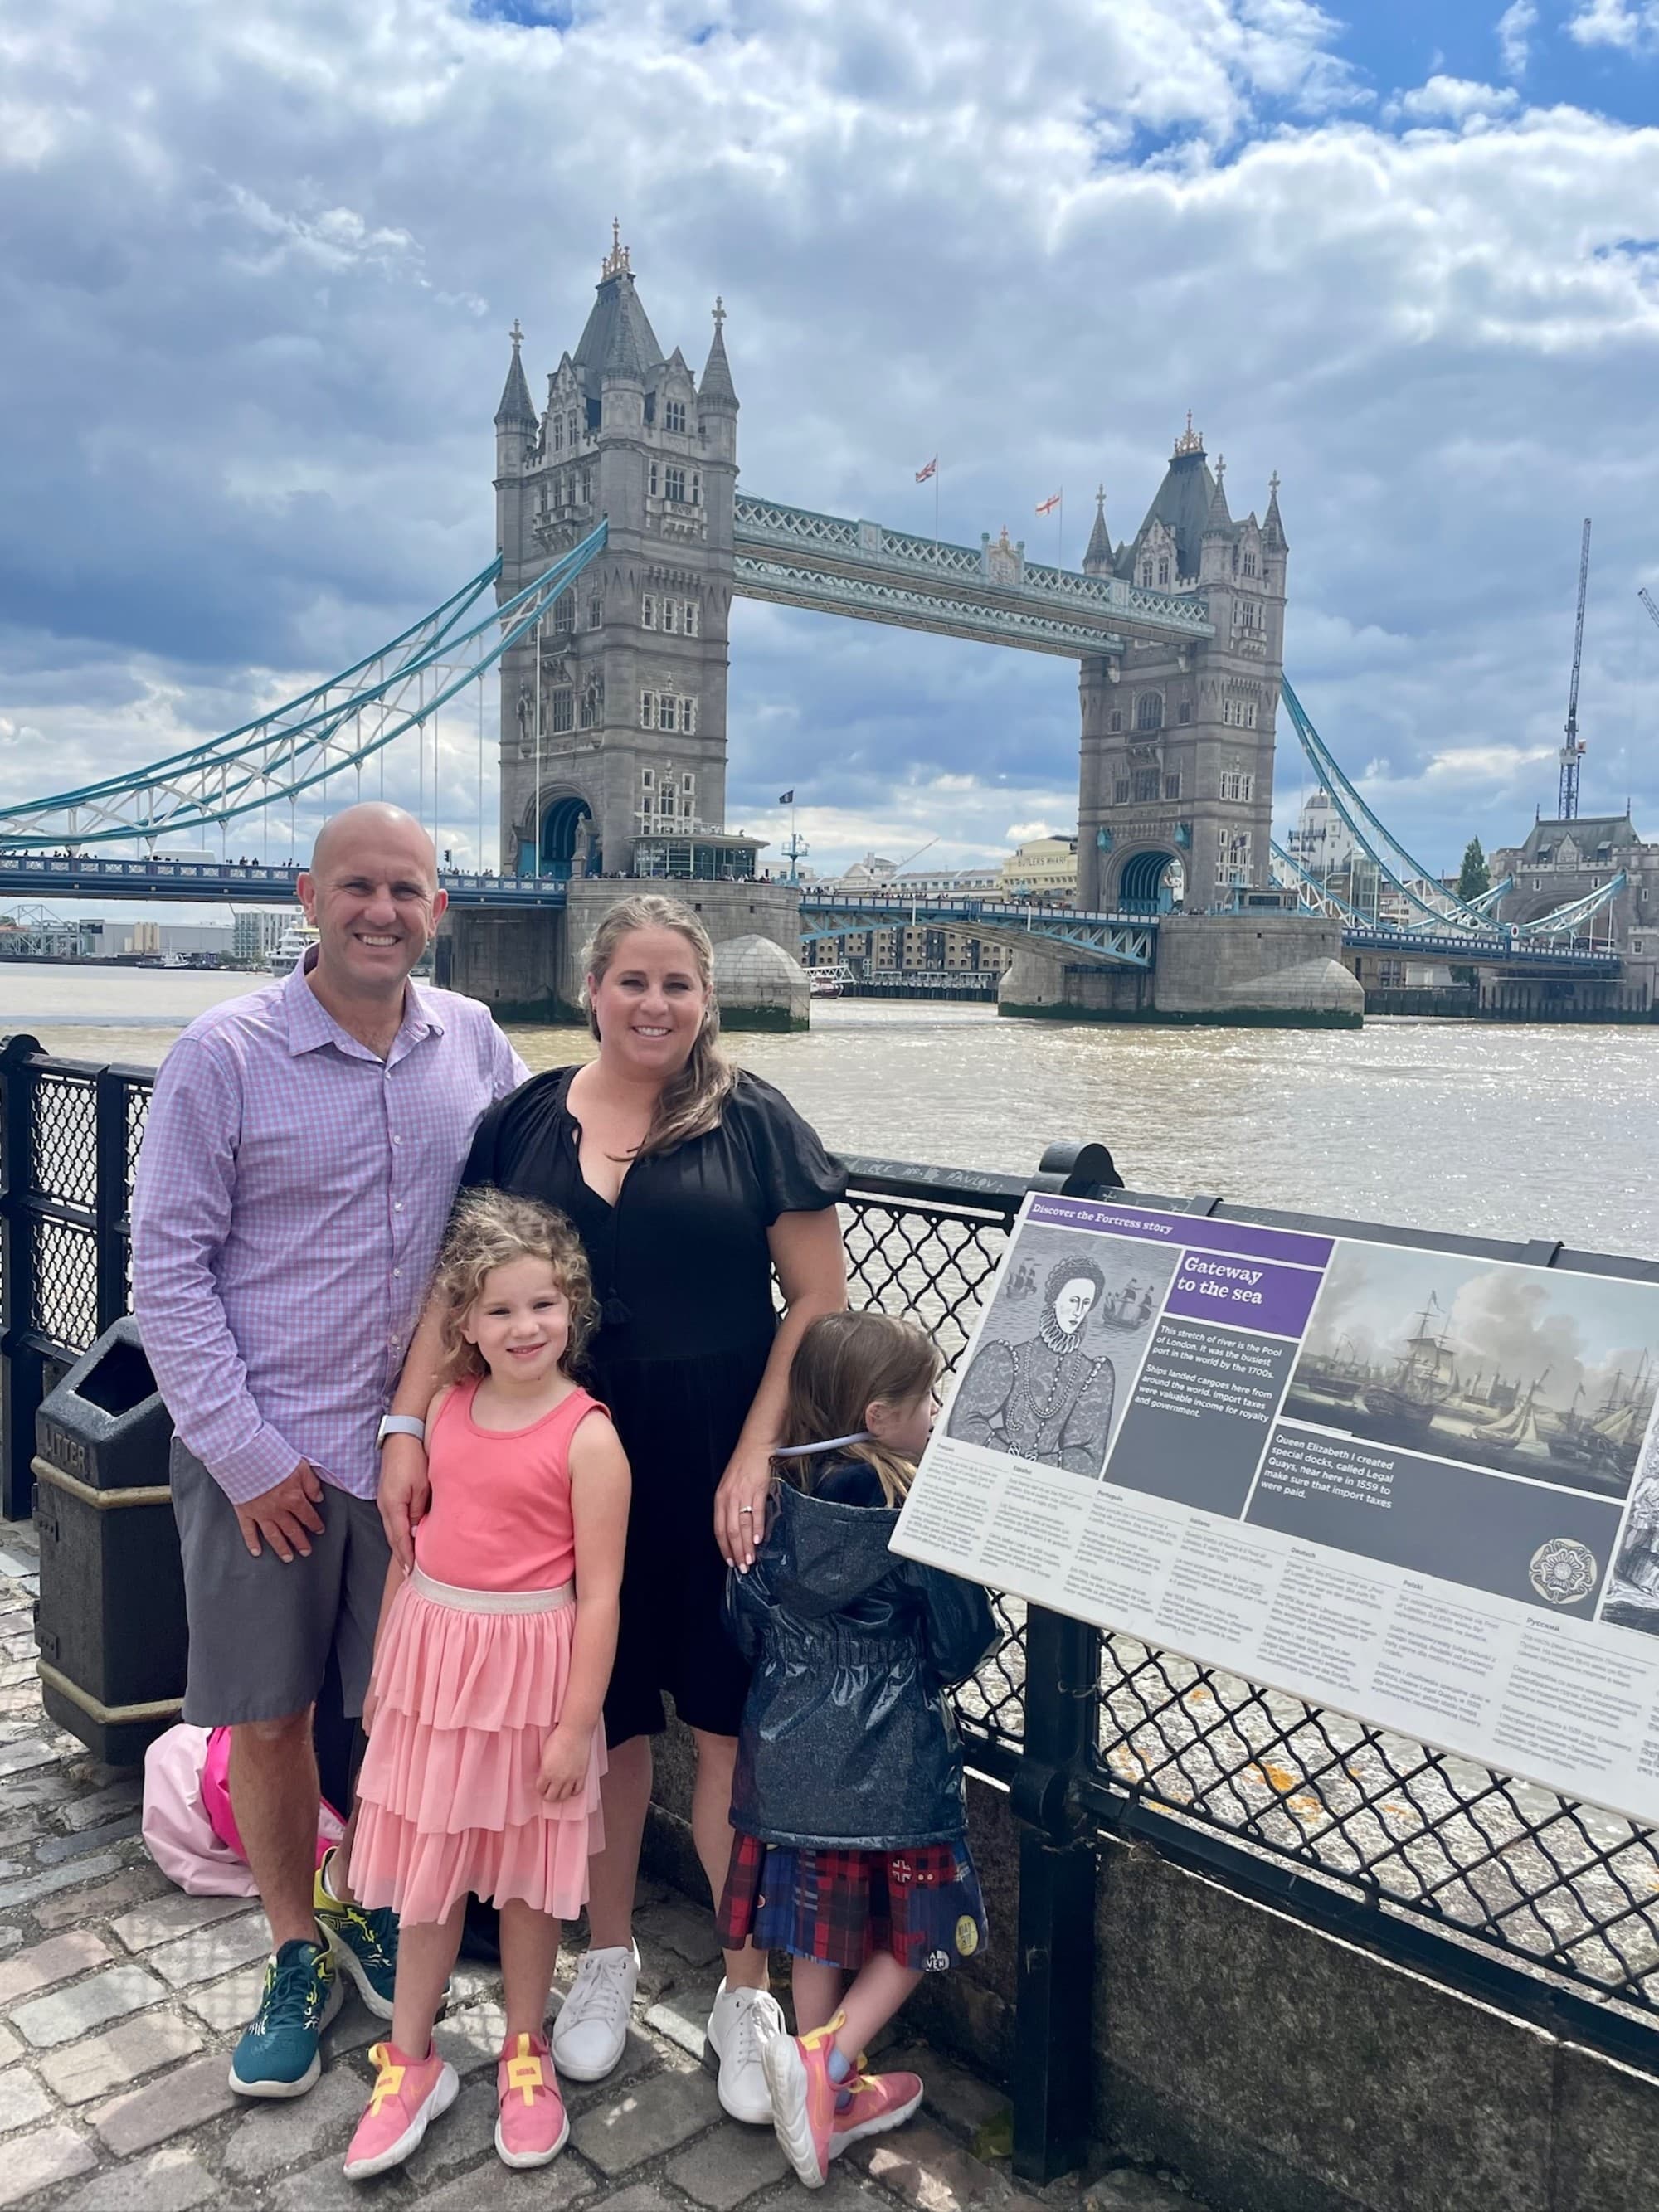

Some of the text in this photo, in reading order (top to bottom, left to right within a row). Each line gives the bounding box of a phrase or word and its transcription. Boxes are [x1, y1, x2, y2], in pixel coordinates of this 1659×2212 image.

[1033, 1204, 1173, 1235] Discover the Fortress story
[1185, 1257, 1262, 1286] Gateway
[1177, 1276, 1262, 1304] to the sea
[1161, 1325, 1282, 1357] This stretch of river is the Pool
[1167, 1339, 1198, 1350] London.
[1208, 1348, 1224, 1356] was
[1226, 1349, 1239, 1359] the
[1241, 1354, 1272, 1367] busiest
[1152, 1346, 1170, 1355] port
[1180, 1352, 1194, 1361] the
[1195, 1356, 1218, 1367] world
[1219, 1360, 1230, 1370] by
[1232, 1363, 1246, 1373] the
[1248, 1366, 1274, 1378] 1700s.
[1141, 1375, 1266, 1410] around the world. Import taxes
[1146, 1364, 1272, 1399] Ships landed cargoes here from
[1135, 1395, 1201, 1417] and government.
[1139, 1386, 1269, 1422] were valuable income for royalty
[1272, 1446, 1394, 1483] special docks, called Legal
[1276, 1434, 1305, 1448] Queen
[1307, 1442, 1349, 1459] Elizabeth
[1357, 1455, 1394, 1470] created
[1262, 1480, 1306, 1498] were paid.
[1264, 1469, 1392, 1508] make sure that import taxes
[1268, 1457, 1297, 1472] Quays,
[1300, 1466, 1321, 1476] near
[1322, 1471, 1343, 1483] here
[1357, 1480, 1379, 1491] 1559
[1380, 1485, 1391, 1495] to
[1526, 1617, 1560, 1631] Русский
